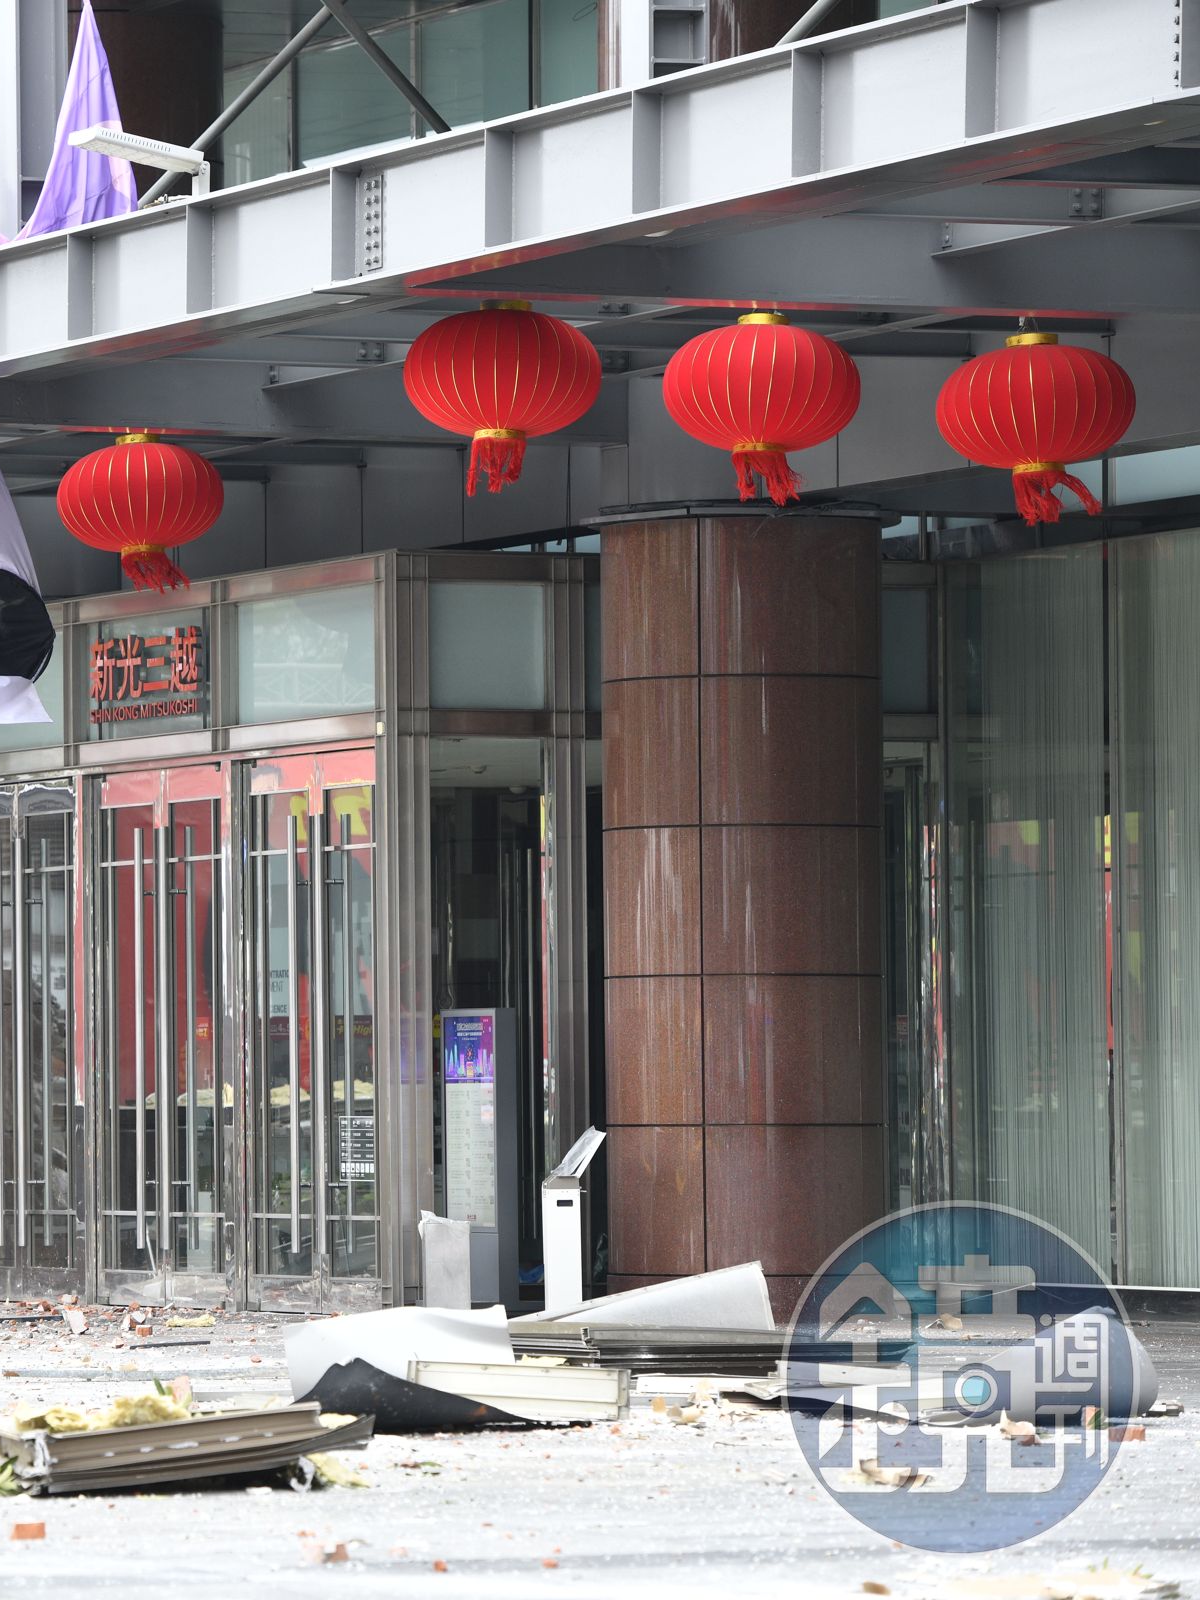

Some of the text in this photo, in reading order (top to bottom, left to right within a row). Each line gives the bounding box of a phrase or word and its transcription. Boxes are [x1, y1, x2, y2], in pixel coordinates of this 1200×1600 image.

[90, 626, 198, 701] 新光三越
[90, 698, 198, 724] SHIN KONG MITSUKOSHI
